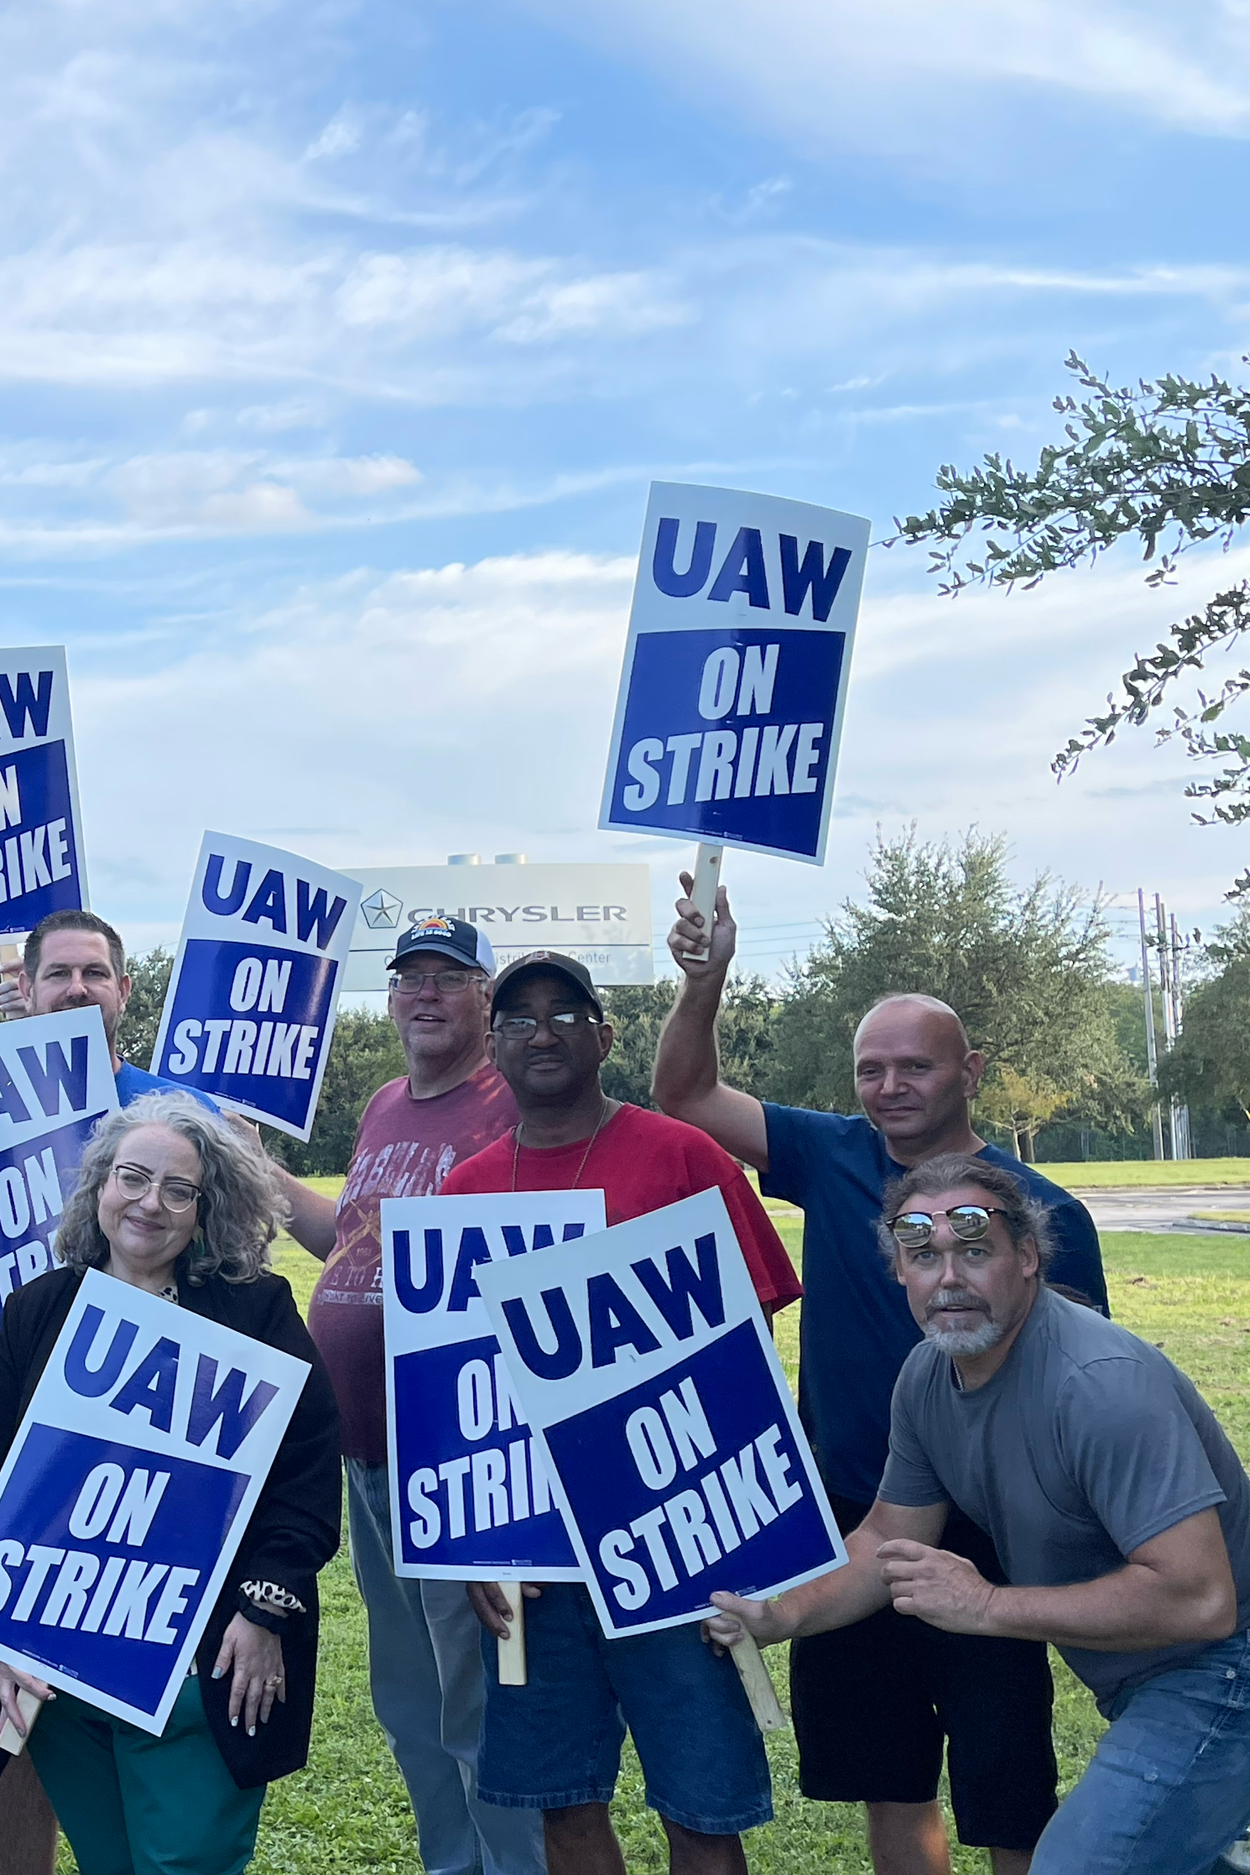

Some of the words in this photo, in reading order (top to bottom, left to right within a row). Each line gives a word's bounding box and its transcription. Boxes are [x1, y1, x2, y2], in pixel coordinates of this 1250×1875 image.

[652, 517, 852, 622] UAW
[697, 643, 779, 720] ON
[622, 722, 824, 812] STRIKE
[201, 853, 347, 950] UAW
[408, 905, 627, 923] CHRYSLER
[229, 957, 291, 1014] ON
[570, 951, 611, 964] Center
[167, 1018, 319, 1080] STRIKE
[501, 1232, 727, 1381] UAW
[63, 1303, 280, 1460] UAW
[625, 1375, 716, 1491] ON
[69, 1462, 170, 1547] ON
[407, 1436, 560, 1549] STRI
[598, 1423, 803, 1611] STRIKE
